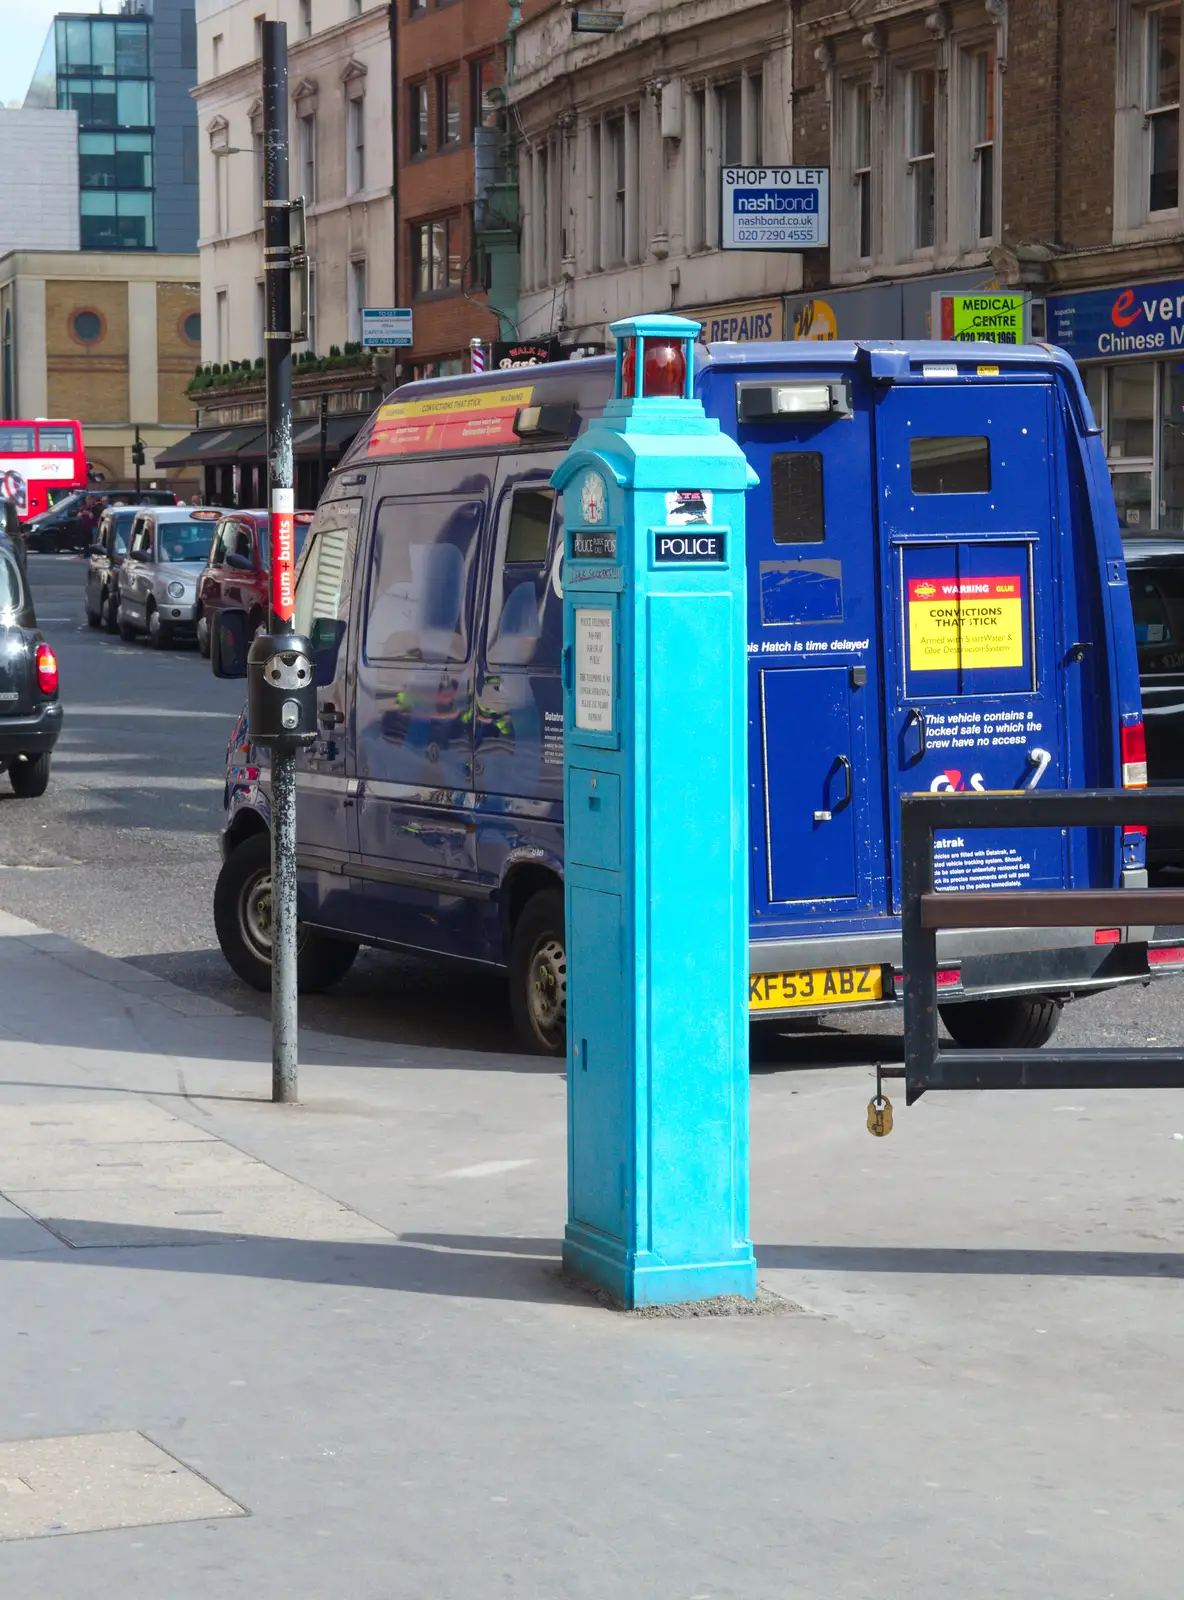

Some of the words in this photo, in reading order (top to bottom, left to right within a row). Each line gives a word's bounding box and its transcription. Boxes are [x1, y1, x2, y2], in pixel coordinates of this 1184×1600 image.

[726, 170, 767, 185] SHOP
[772, 170, 792, 185] TO
[796, 170, 824, 184] LET
[738, 193, 814, 210] nashbond
[738, 216, 812, 226] nashbond.co.uk
[738, 230, 758, 240] 020
[760, 230, 786, 240] 7290
[788, 230, 813, 240] 4555
[962, 299, 1016, 310] MEDICAL
[972, 316, 1016, 326] CENTRE
[694, 321, 707, 345] E
[711, 312, 772, 342] REPAIRS
[1098, 332, 1164, 352] Chinese
[509, 346, 536, 356] WALK
[278, 520, 290, 560] butts
[575, 539, 593, 552] POLICE
[661, 538, 716, 555] POLICE
[280, 573, 293, 606] gum
[942, 584, 989, 594] WARNING
[930, 607, 1002, 617] CONVICTIONS
[936, 618, 966, 627] THAT
[969, 618, 997, 626] STICK
[762, 640, 791, 652] Hatch
[794, 641, 803, 651] is
[806, 640, 828, 650] time
[831, 639, 869, 651] delayed
[924, 646, 941, 654] Glue
[926, 714, 945, 725] This
[948, 712, 980, 723] vehicle
[984, 712, 1024, 722] contains
[926, 726, 958, 736] locked
[961, 725, 980, 735] safe
[984, 725, 993, 734] to
[996, 723, 1024, 733] which
[1026, 722, 1042, 731] the
[926, 739, 950, 748] crew
[952, 737, 974, 747] have
[977, 738, 989, 746] no
[992, 736, 1026, 744] access
[749, 972, 814, 1001] KF53
[823, 968, 871, 995] ABZ
